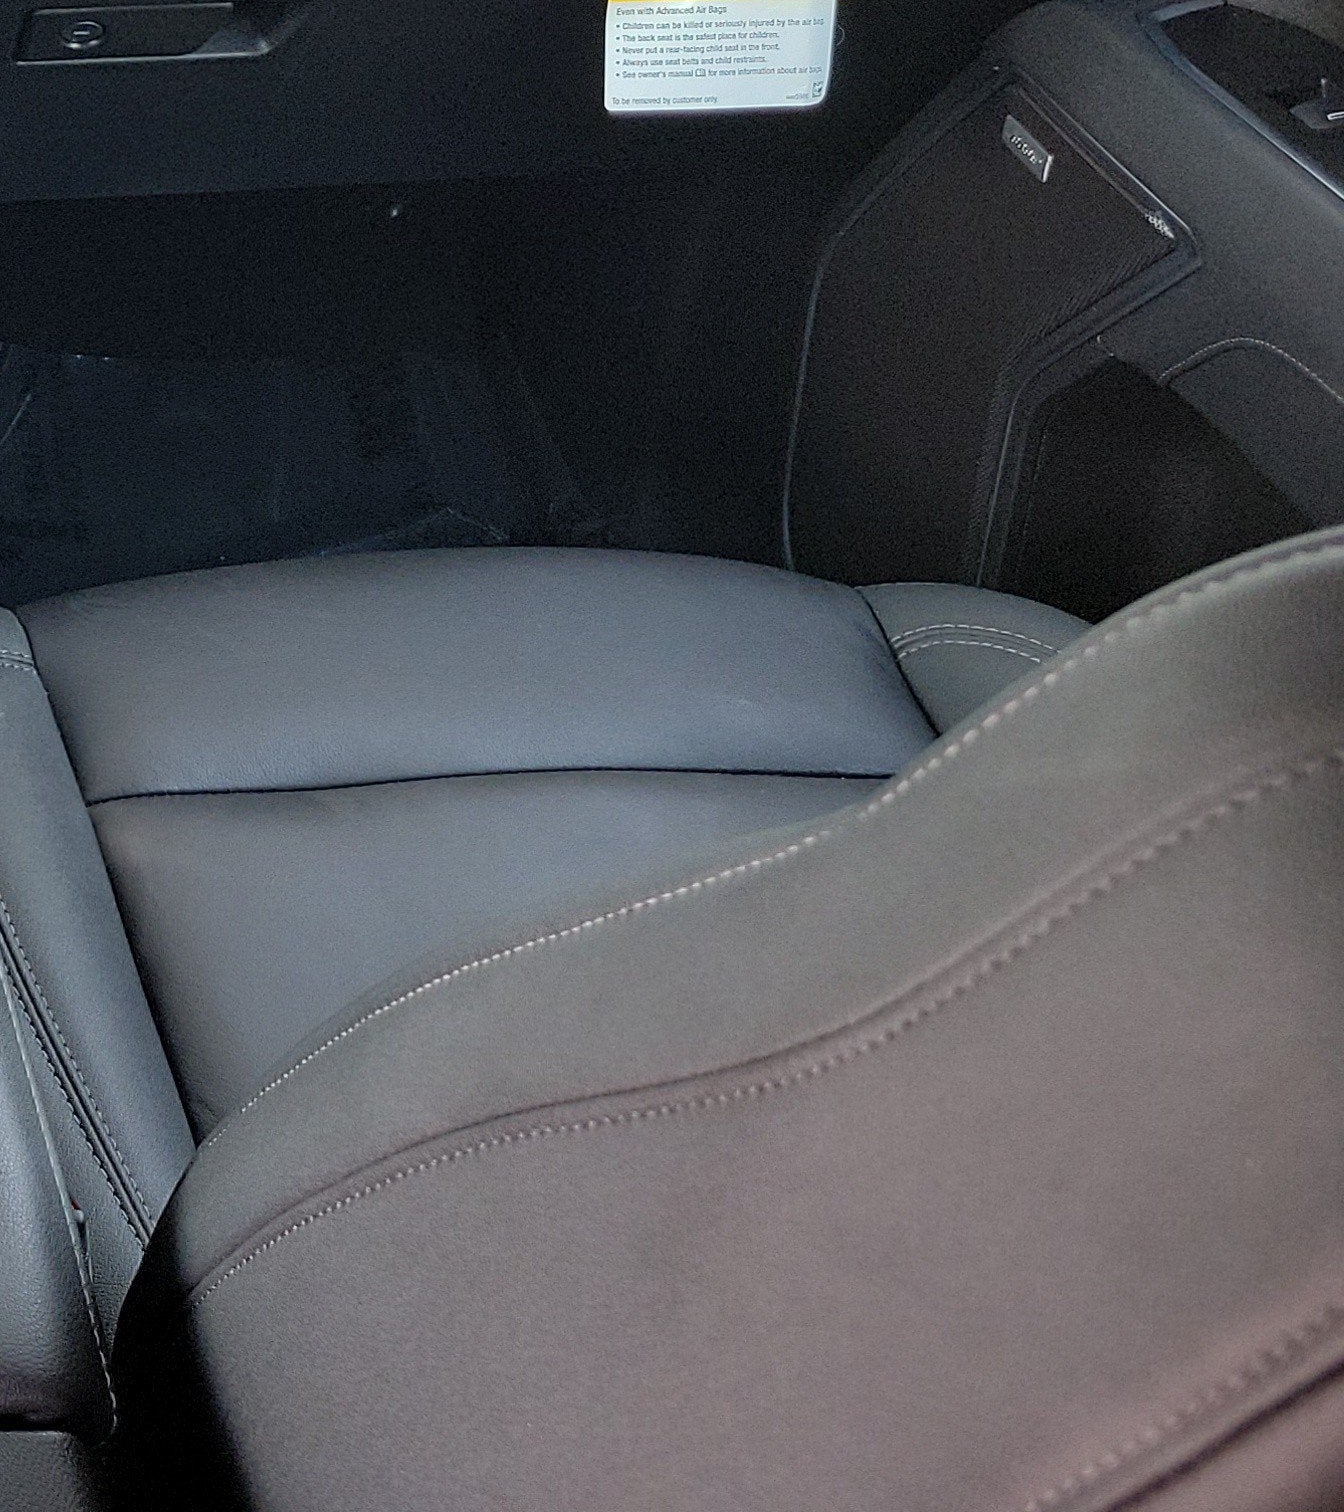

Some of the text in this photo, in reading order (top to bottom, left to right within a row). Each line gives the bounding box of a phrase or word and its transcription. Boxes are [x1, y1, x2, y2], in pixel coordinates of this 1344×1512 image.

[616, 5, 727, 16] Even with Advanced Air Bags
[776, 18, 786, 28] by
